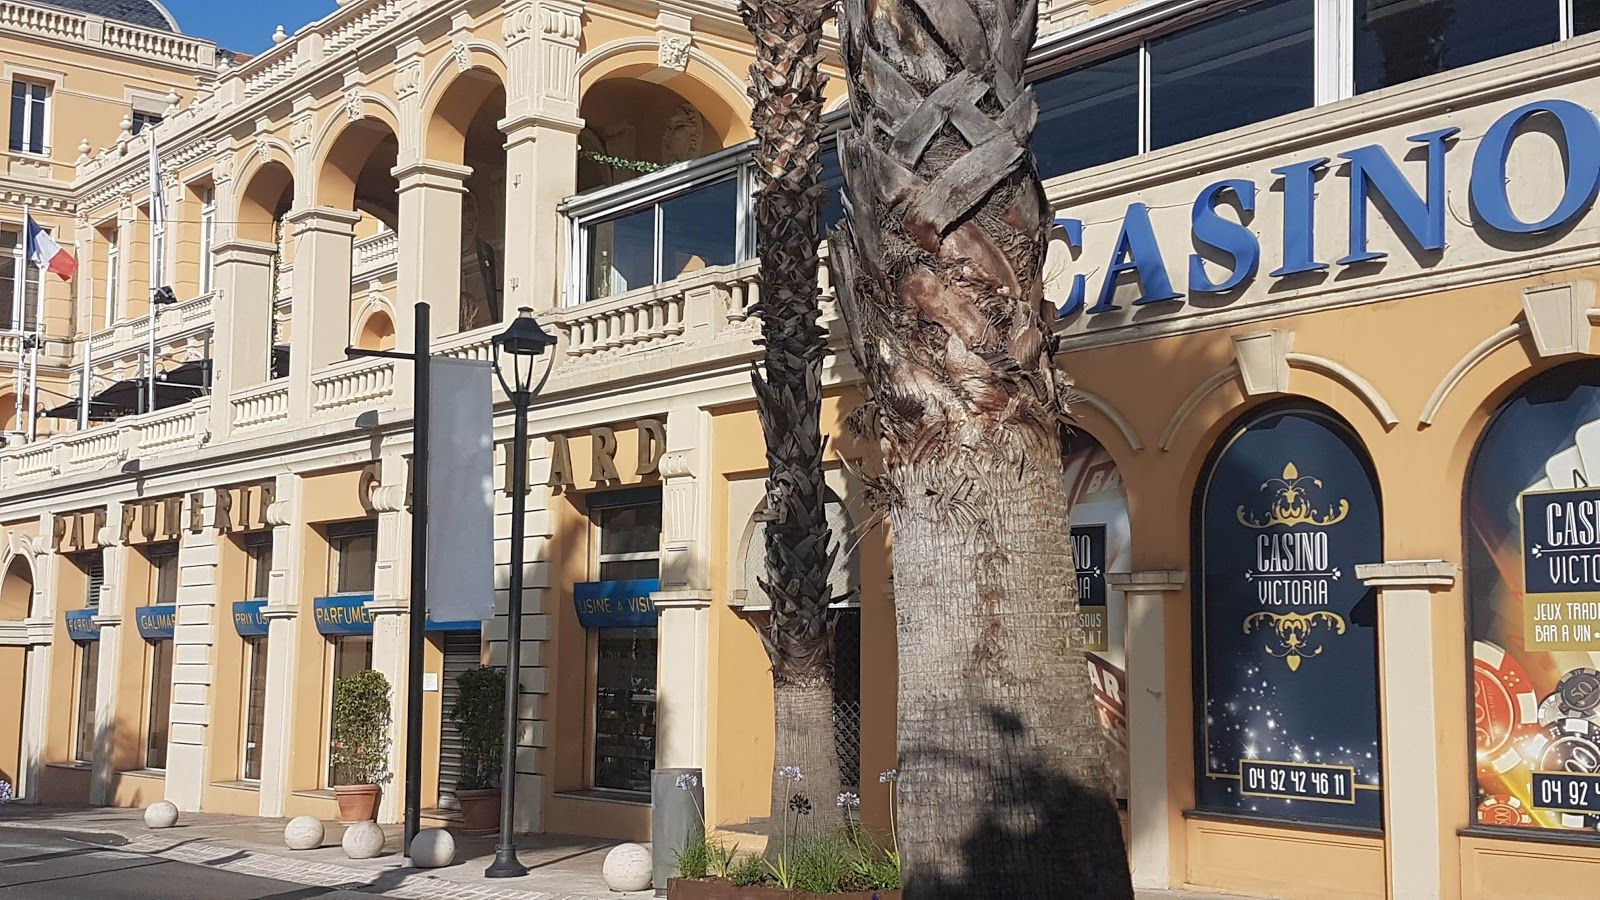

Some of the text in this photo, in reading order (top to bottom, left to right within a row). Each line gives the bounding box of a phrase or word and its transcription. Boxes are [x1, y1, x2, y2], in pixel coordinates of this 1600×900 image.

[1257, 532, 1328, 572] CASINO
[1258, 580, 1328, 605] VICTORIA
[235, 612, 252, 625] PRIX
[1079, 613, 1101, 628] SOUS
[1533, 603, 1562, 620] JEUX
[1535, 625, 1591, 642] BAR A VIN
[1249, 768, 1345, 796] 04 92 42 46 11
[1541, 780, 1561, 803] 04
[1569, 781, 1588, 806] 92
